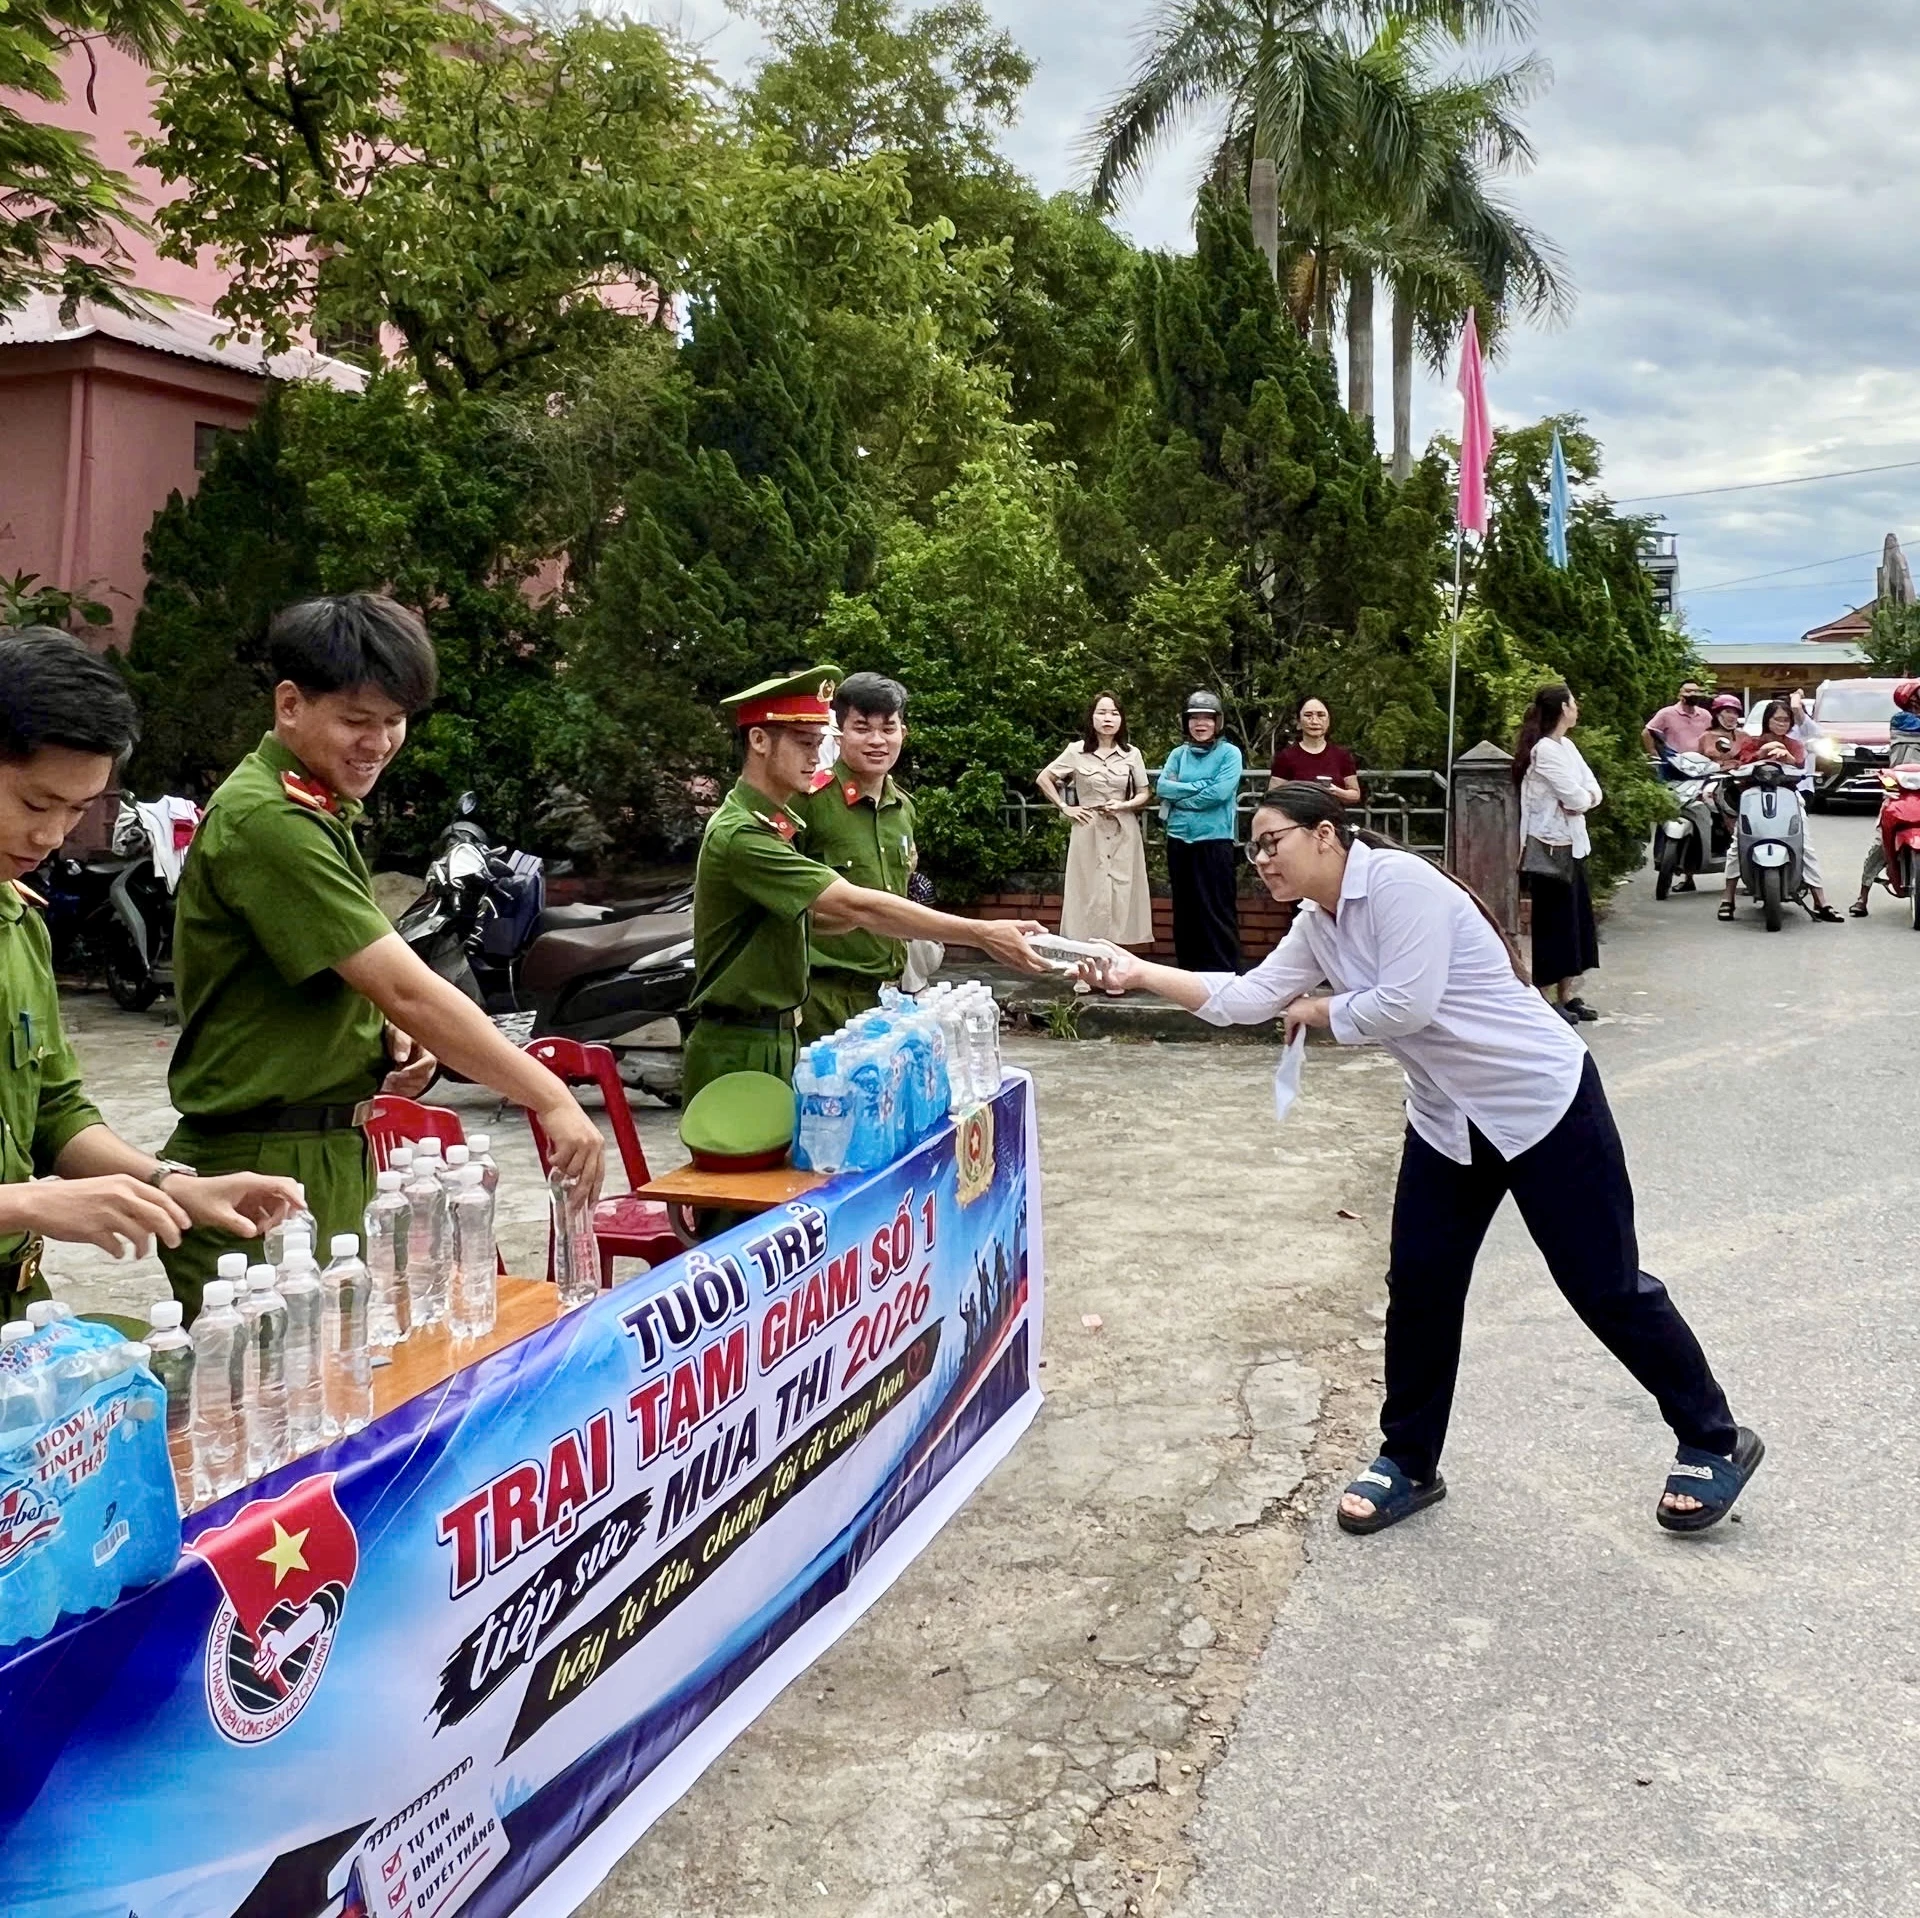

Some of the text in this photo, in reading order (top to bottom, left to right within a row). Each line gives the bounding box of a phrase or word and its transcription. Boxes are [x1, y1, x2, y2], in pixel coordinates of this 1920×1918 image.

[622, 1204, 825, 1367] TUỔI TRẺ
[37, 1439, 83, 1482] TINH
[440, 1188, 936, 1593] TRẠI TẠM GIAM SỐ 1
[470, 1262, 932, 1691] tiếp sức MÙA THI 2026
[548, 1368, 905, 1701] hãy tự tin, chúng tôi đi cùng bạn
[406, 1807, 450, 1854] TỰ TIN
[411, 1841, 445, 1883] BÌNH
